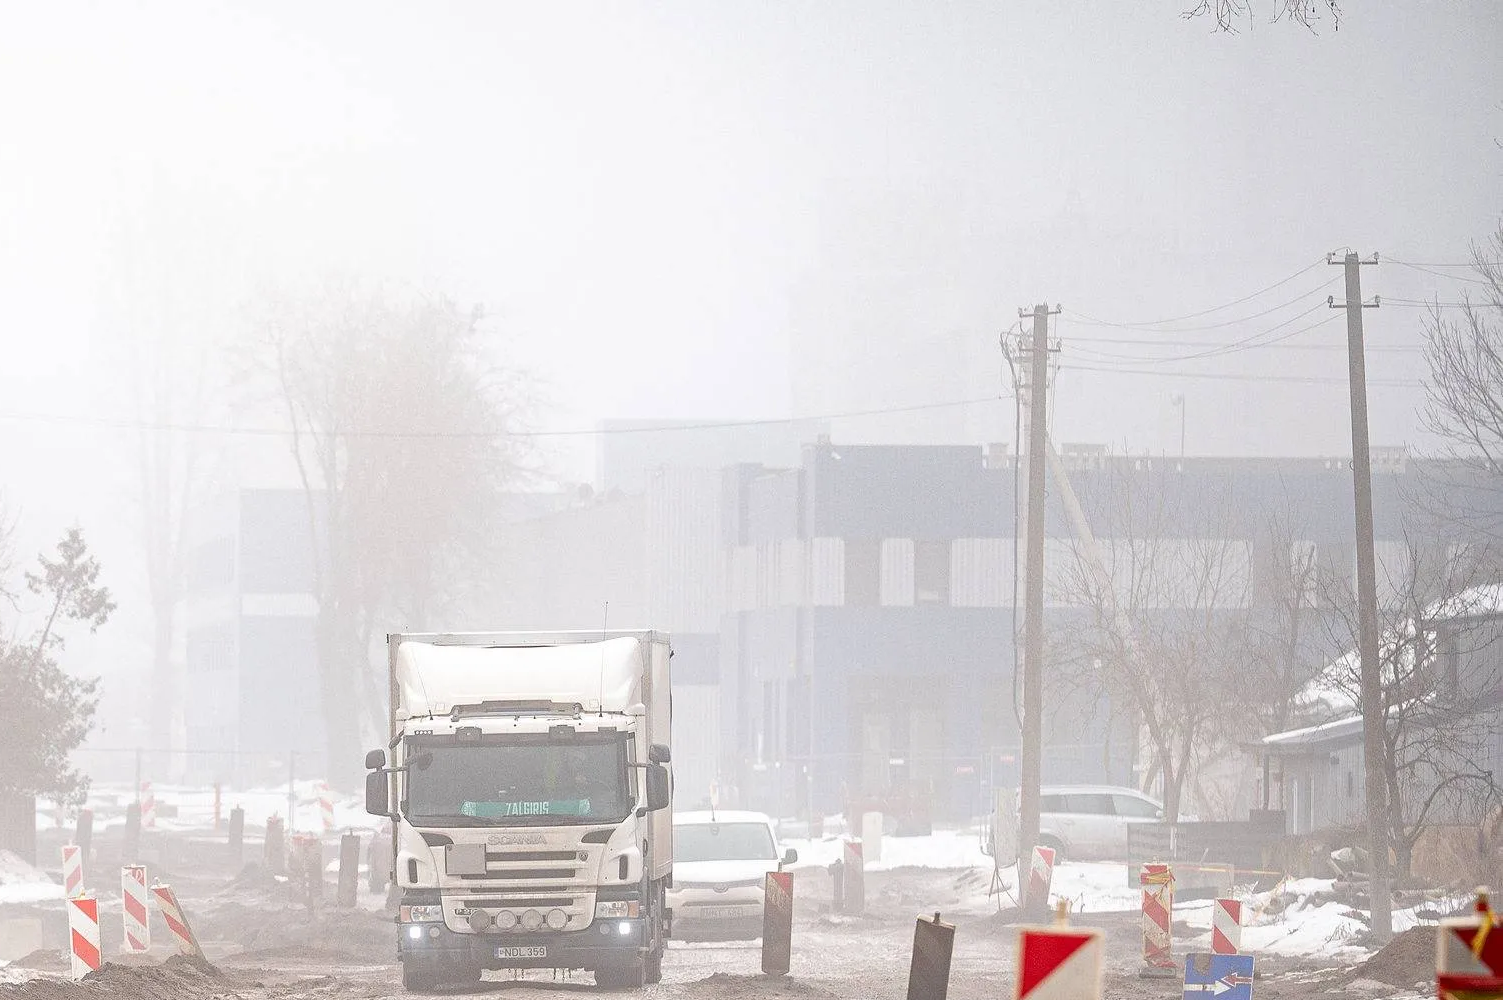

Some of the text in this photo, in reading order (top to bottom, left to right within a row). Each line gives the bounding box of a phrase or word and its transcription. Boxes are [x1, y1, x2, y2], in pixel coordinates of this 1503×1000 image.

[487, 833, 547, 845] SCANIA
[504, 947, 545, 957] NDL 359
